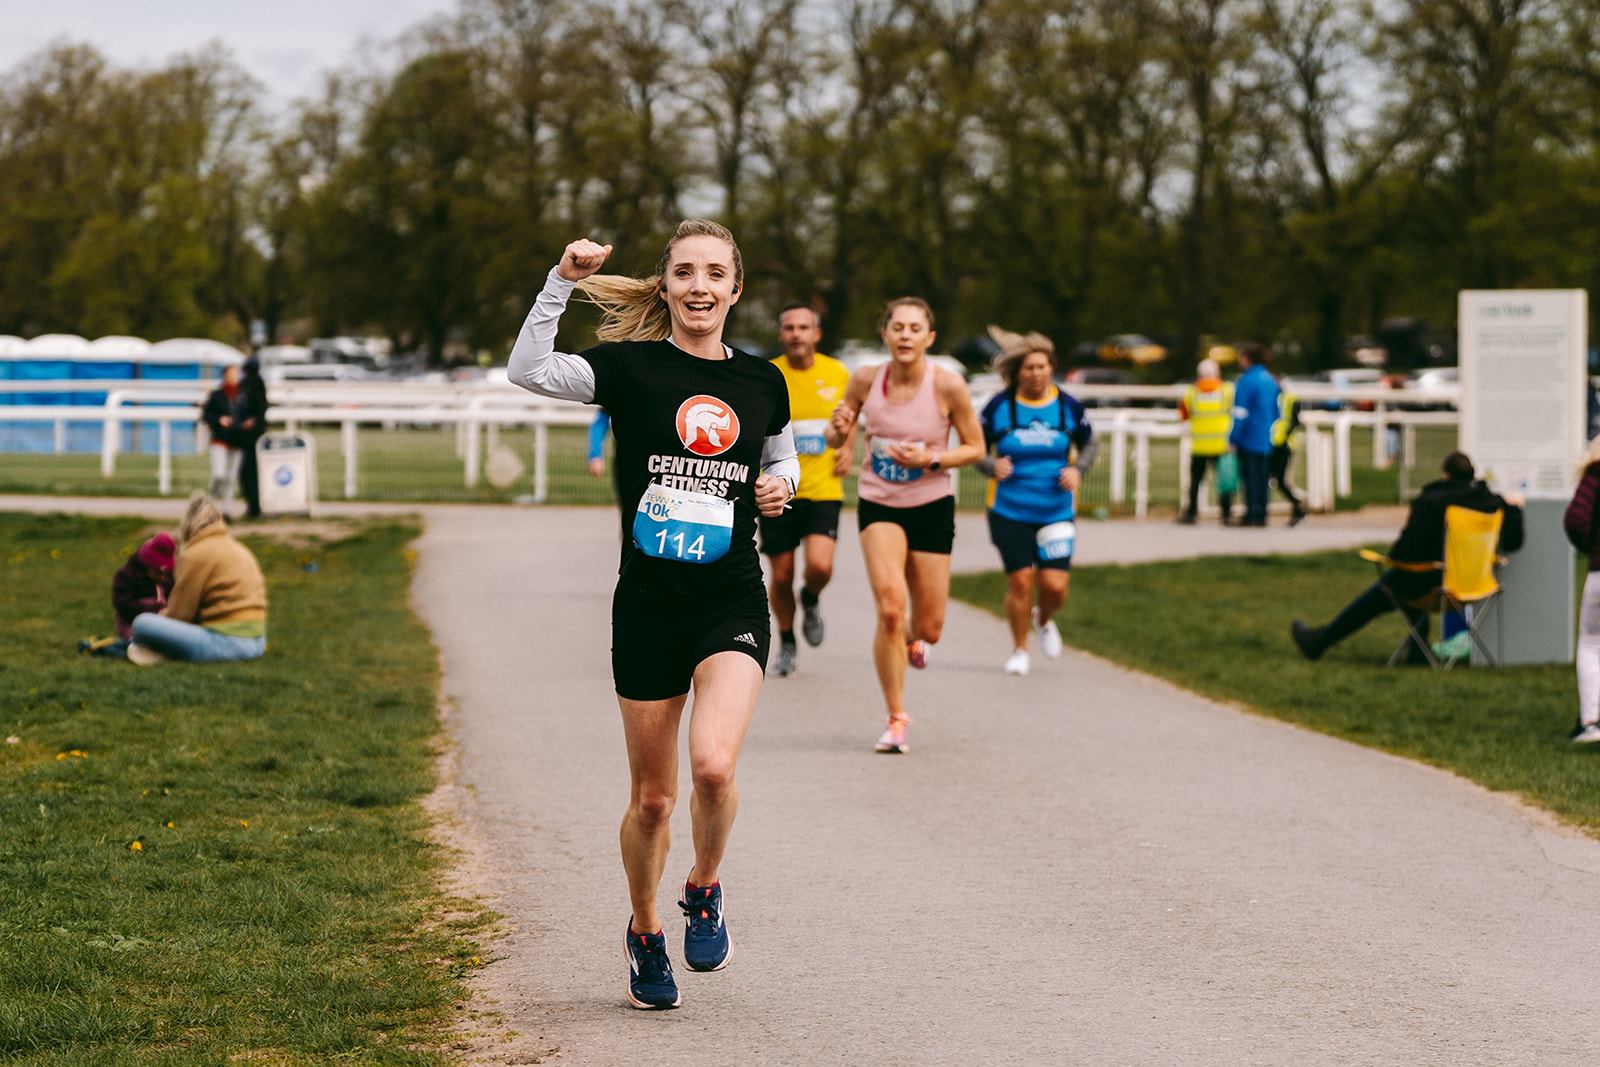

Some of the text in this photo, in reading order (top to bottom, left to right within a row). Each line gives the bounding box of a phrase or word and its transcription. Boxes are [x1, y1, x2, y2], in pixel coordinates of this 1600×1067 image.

[647, 454, 750, 484] CENTURION
[878, 460, 911, 482] 213
[645, 501, 671, 518] 10k
[655, 528, 706, 561] 114
